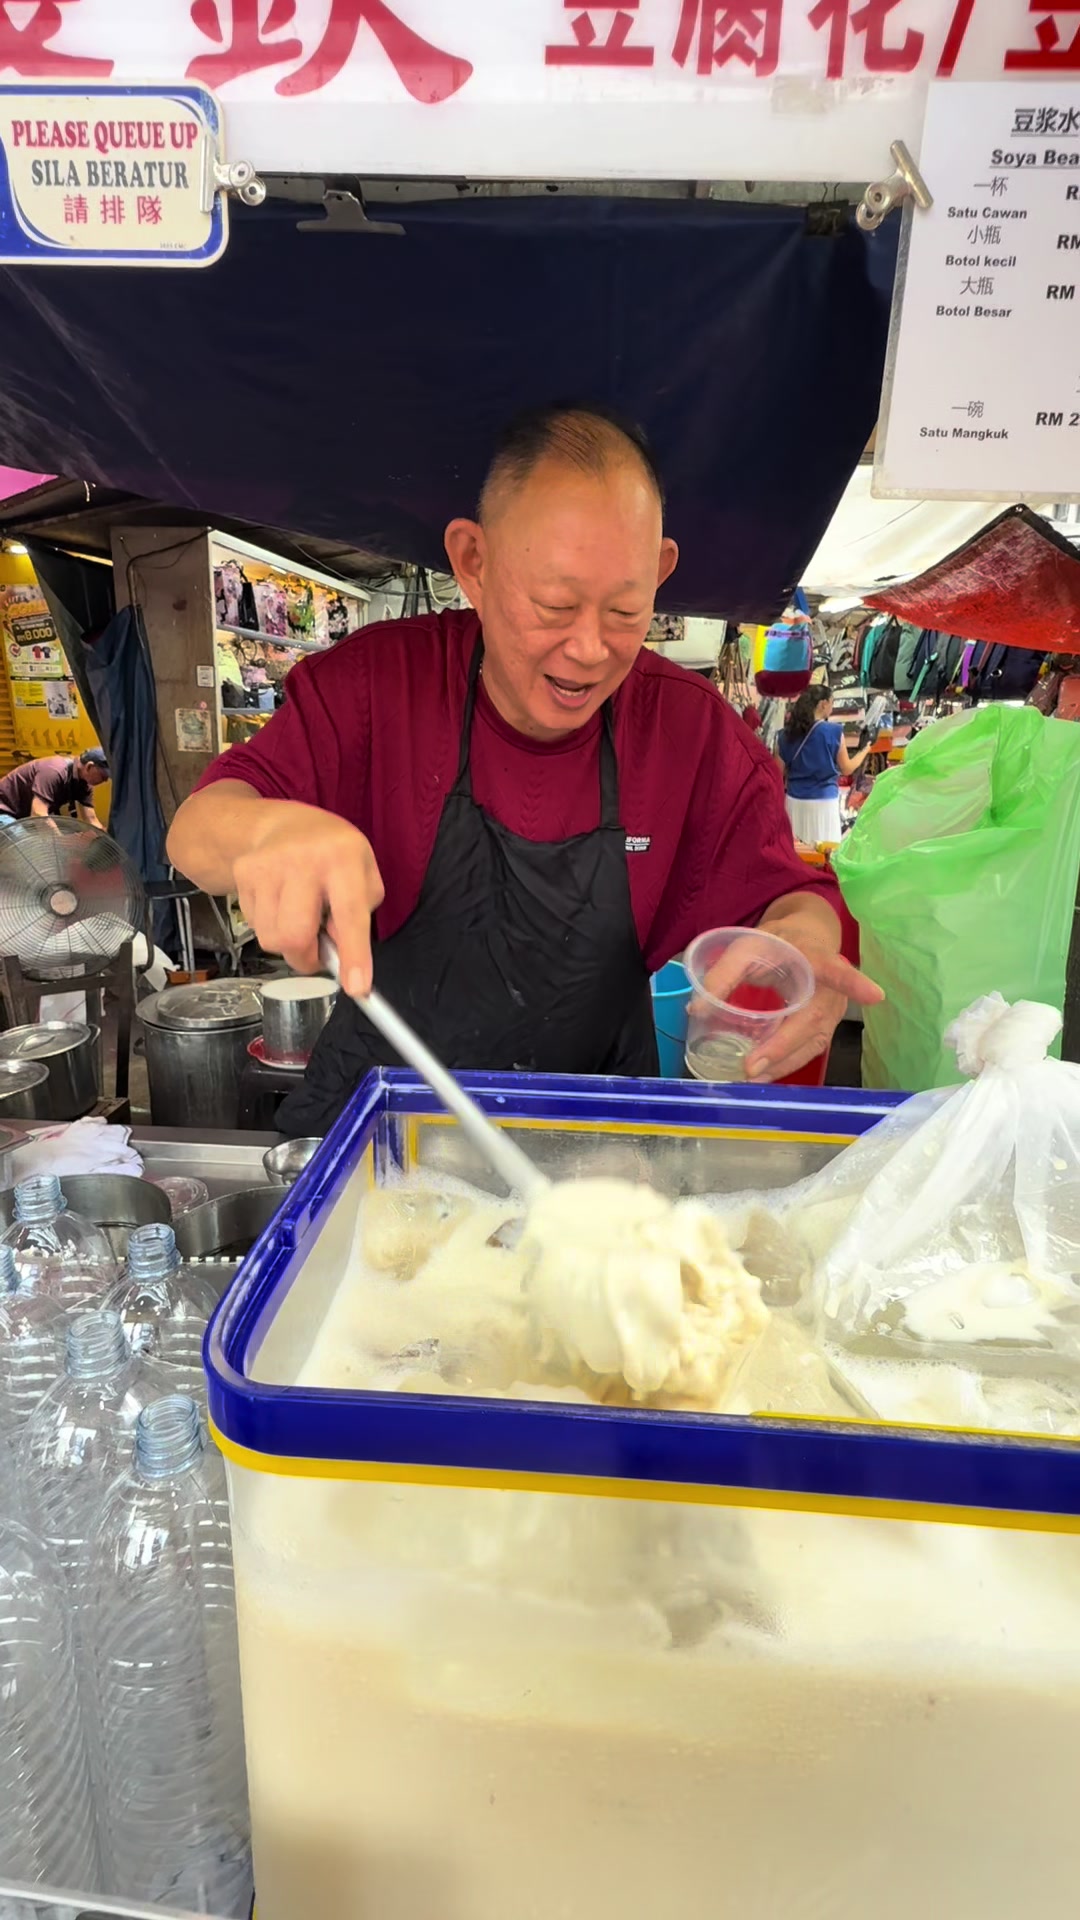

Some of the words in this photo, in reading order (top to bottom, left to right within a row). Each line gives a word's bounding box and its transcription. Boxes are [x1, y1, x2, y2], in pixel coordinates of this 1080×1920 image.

[1011, 107, 1080, 133] 豆浆水
[11, 120, 90, 148] PLEASE
[94, 121, 166, 154] QUEUE
[170, 122, 198, 149] UP
[991, 150, 1037, 168] Soya
[1043, 150, 1080, 165] Bea
[32, 160, 81, 187] SILA
[86, 160, 189, 188] BERATUR
[973, 176, 1009, 197] 一杯
[1066, 185, 1080, 200] R
[63, 193, 163, 225] 請排隊
[947, 207, 978, 219] Satu
[982, 207, 1028, 219] Cawan
[967, 225, 1002, 245] 小瓶
[945, 255, 980, 267] Botol
[984, 256, 1017, 267] kecil
[959, 276, 994, 296] 大瓶
[1046, 285, 1075, 300] RM
[936, 306, 970, 317] Botol
[974, 306, 1012, 318] Besar
[951, 401, 984, 418] 一碗
[1035, 412, 1063, 426] RM
[919, 427, 948, 438] Satu
[952, 428, 1009, 441] Mangkuk
